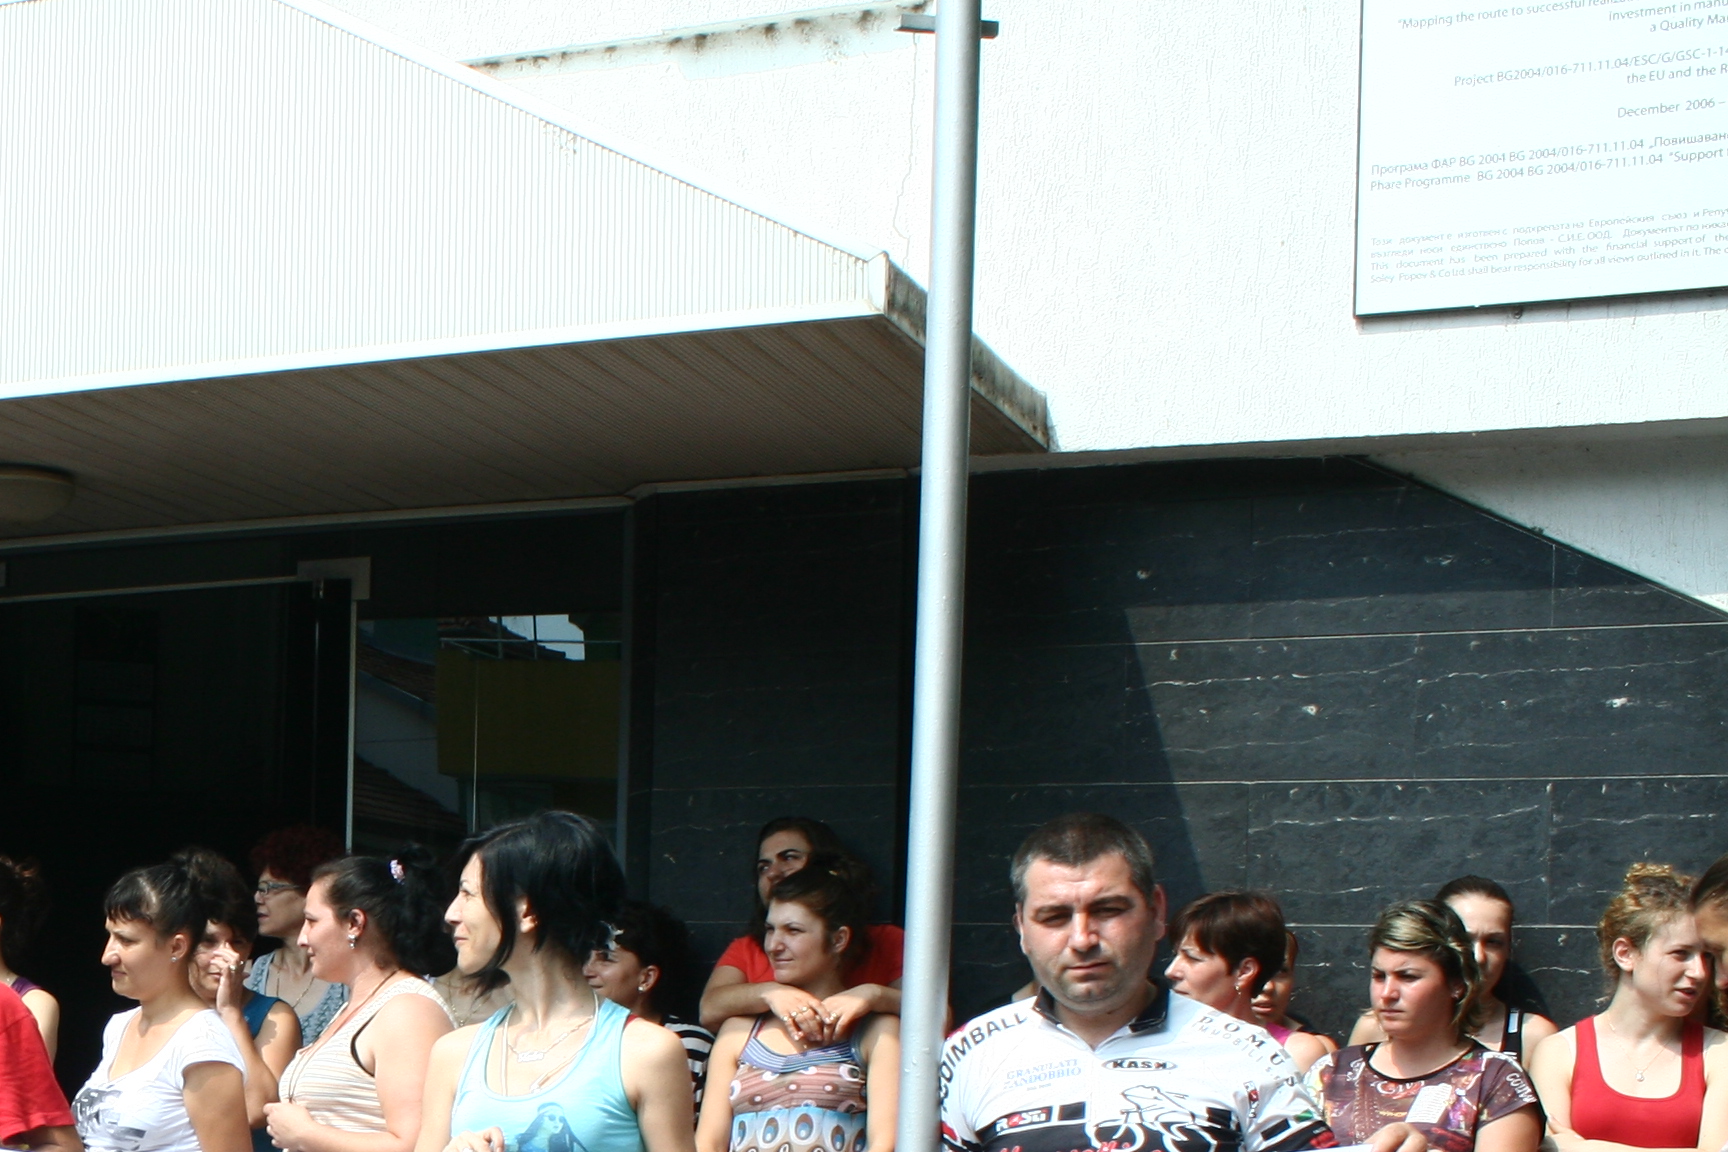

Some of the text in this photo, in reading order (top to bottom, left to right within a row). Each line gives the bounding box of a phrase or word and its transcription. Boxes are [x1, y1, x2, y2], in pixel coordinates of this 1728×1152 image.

[1456, 12, 1474, 23] the
[1478, 8, 1508, 20] route
[1511, 6, 1523, 16] to
[1527, 0, 1585, 15] successful
[1609, 4, 1676, 21] investment
[1680, 2, 1691, 12] in
[1650, 24, 1656, 32] a
[1660, 17, 1703, 31] Quality
[1454, 73, 1494, 87] Project
[1627, 72, 1647, 84] the
[1649, 70, 1665, 82] EU
[1668, 66, 1691, 79] and
[1696, 65, 1716, 77] the
[1617, 102, 1680, 118] December
[1685, 97, 1715, 110] 2006
[1371, 162, 1428, 177] Програма
[1431, 157, 1456, 169] ФАР
[1459, 155, 1475, 167] BG
[1478, 153, 1505, 165] 2004
[1509, 150, 1526, 162] BG
[1529, 138, 1644, 160] 2004/016-711.11.04
[1370, 180, 1402, 191] Phare
[1405, 173, 1470, 189] Programme
[1477, 170, 1493, 181] BG
[1496, 168, 1523, 179] 2004
[1528, 165, 1544, 177] BG
[1547, 154, 1663, 175] 2004/016-711.11.04
[1371, 262, 1389, 270] This
[1396, 258, 1444, 269] document
[1449, 256, 1465, 264] has
[1474, 254, 1498, 262] been
[1504, 248, 1547, 262] prepared
[1554, 246, 1575, 256] with
[1582, 244, 1598, 254] the
[1606, 239, 1647, 251] financial
[1654, 237, 1692, 248] support
[1695, 234, 1706, 243] of
[1430, 270, 1436, 278] &
[1468, 266, 1488, 275] shall
[1491, 264, 1511, 274] bear
[1514, 258, 1577, 273] responsibility
[1579, 258, 1592, 267] for
[1594, 256, 1605, 265] all
[1608, 254, 1634, 264] views
[1637, 250, 1677, 262] outlined
[1704, 246, 1721, 256] The
